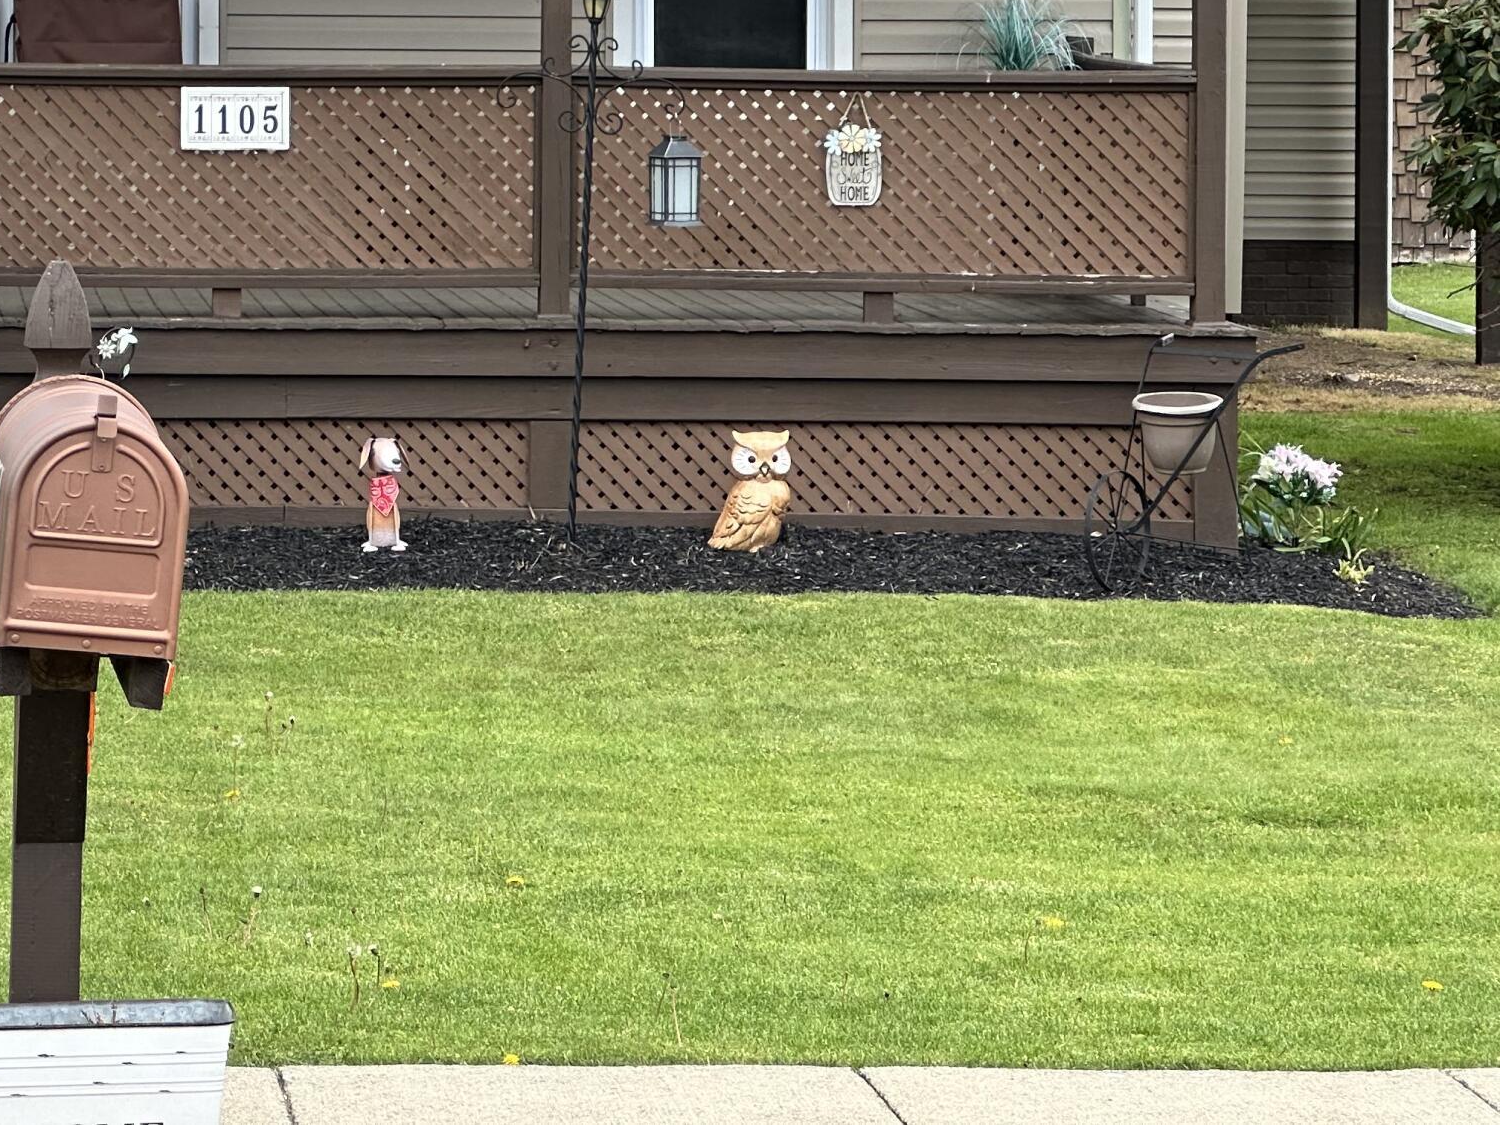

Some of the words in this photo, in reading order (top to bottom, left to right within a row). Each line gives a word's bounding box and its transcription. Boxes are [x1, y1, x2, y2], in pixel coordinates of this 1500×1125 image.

[194, 104, 279, 134] 1105
[840, 151, 870, 166] HOME
[840, 186, 870, 201] HOME
[36, 500, 156, 538] MAIL
[29, 595, 97, 612] APPROVED
[103, 602, 119, 613] BY
[123, 603, 149, 615] THE
[16, 606, 98, 624] POSTMASTER
[103, 614, 159, 629] GENERAL
